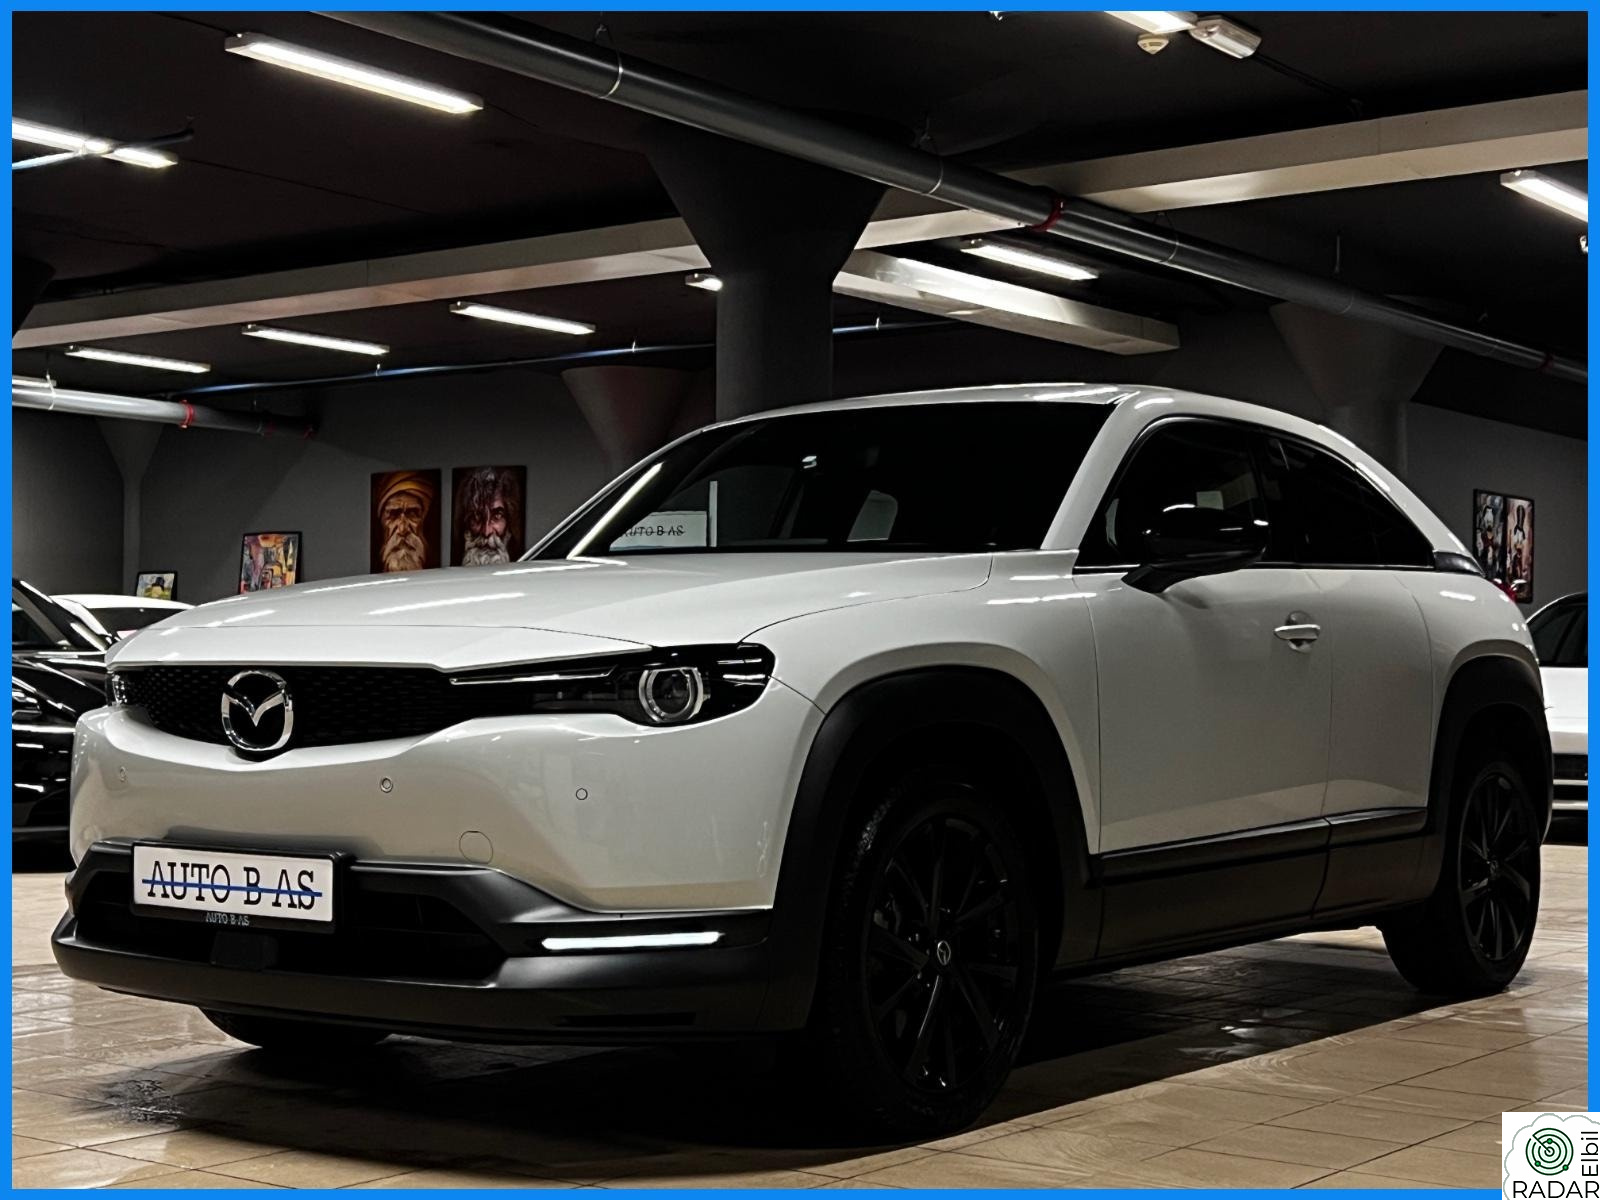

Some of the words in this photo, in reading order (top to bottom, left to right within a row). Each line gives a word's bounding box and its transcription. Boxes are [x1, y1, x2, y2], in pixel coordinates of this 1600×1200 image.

[656, 525, 665, 536] B
[147, 860, 231, 904] AUTO
[243, 866, 262, 905] B
[271, 868, 316, 911] AS
[206, 911, 228, 925] AUTO
[229, 913, 237, 925] B
[238, 915, 250, 927] AS
